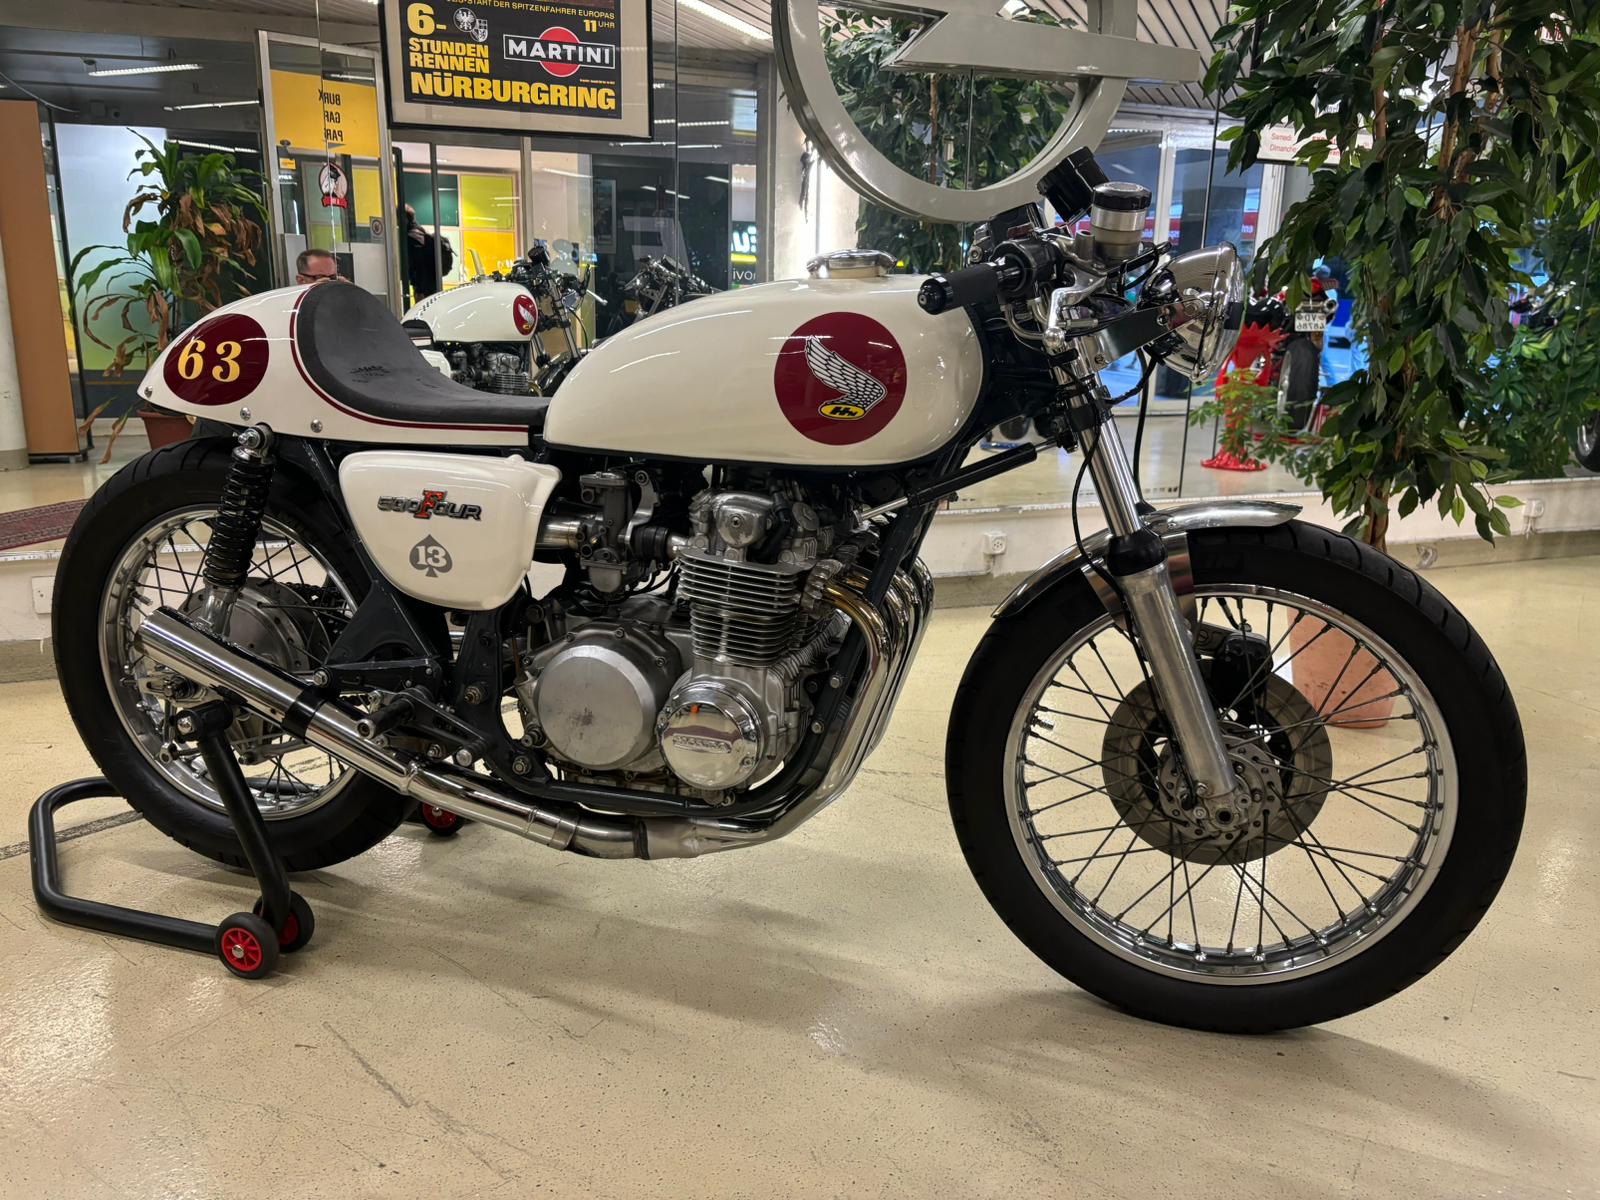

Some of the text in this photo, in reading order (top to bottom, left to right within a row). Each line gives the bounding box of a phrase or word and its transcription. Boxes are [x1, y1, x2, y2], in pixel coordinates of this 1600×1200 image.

[493, 0, 510, 9] DER
[511, 2, 577, 16] SPITZENFAHRER
[578, 10, 615, 20] EUROPAS
[583, 19, 615, 33] 11 UHR
[408, 37, 489, 59] STUNDEN
[508, 39, 611, 65] MARTINI
[409, 52, 490, 74] RENNEN
[410, 71, 616, 111] NÜRBURGRING
[1270, 132, 1293, 142] Samedi
[1269, 143, 1298, 154] Dimanche
[177, 336, 242, 383] 63
[416, 545, 448, 569] 13
